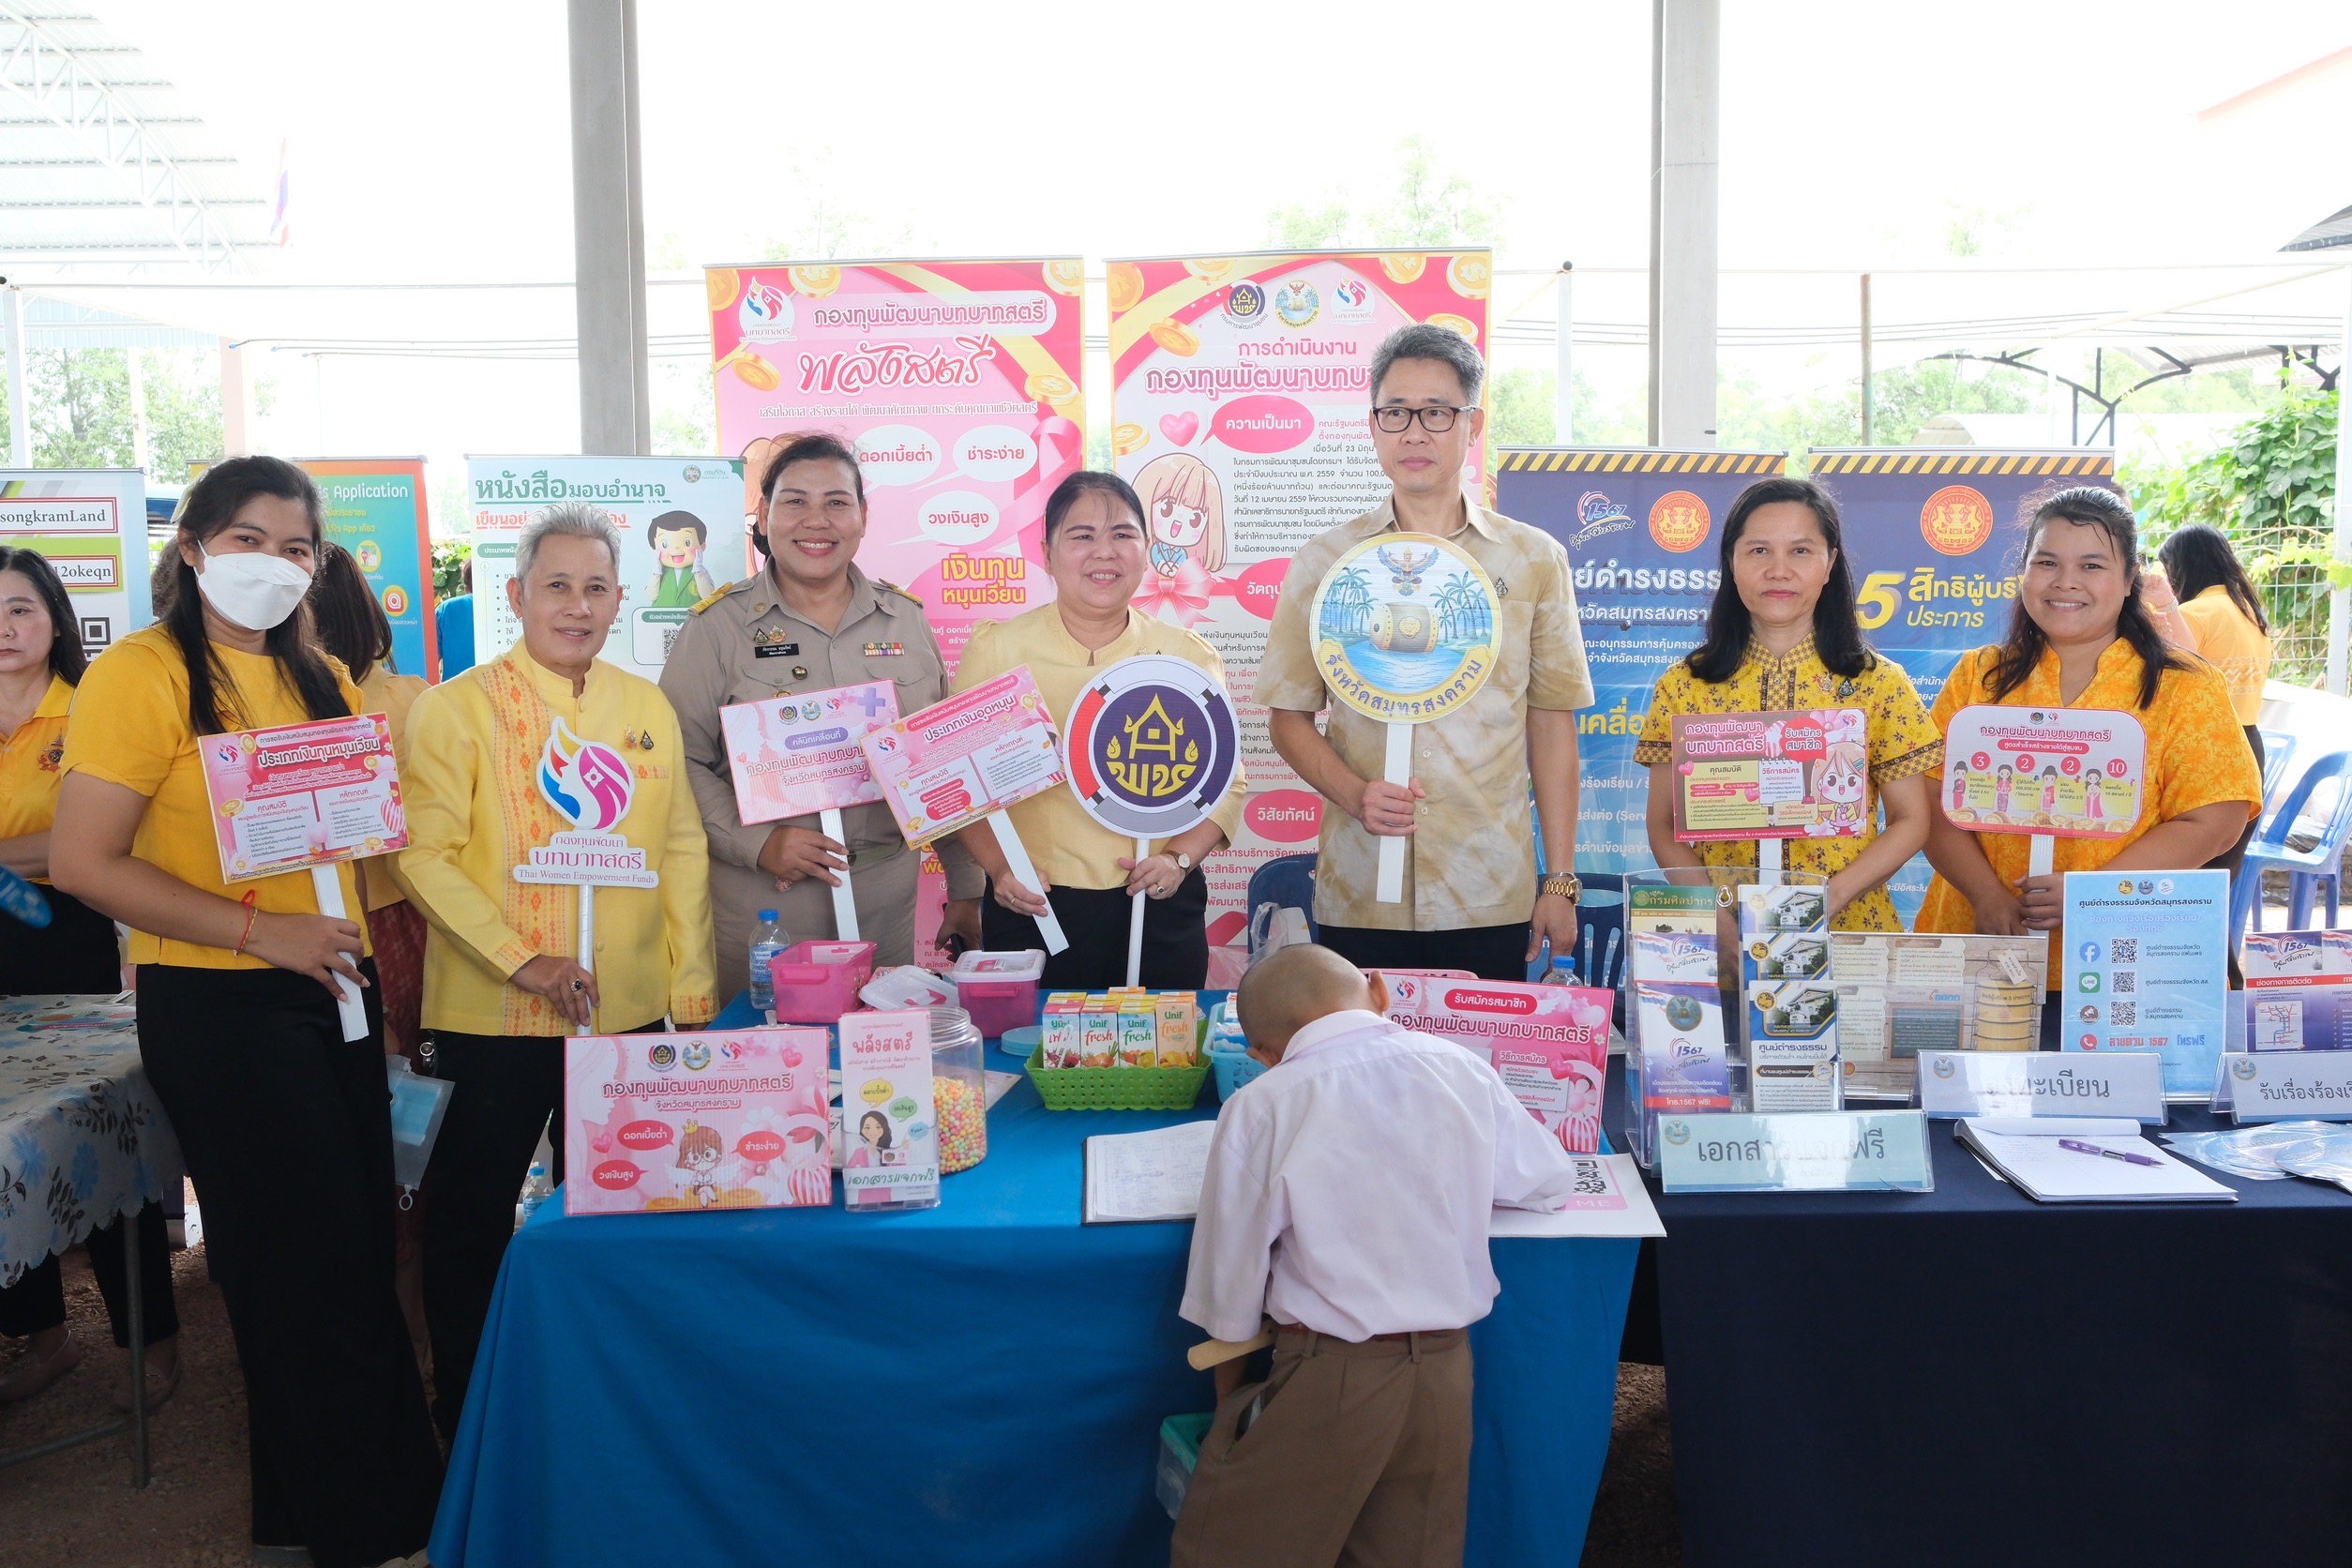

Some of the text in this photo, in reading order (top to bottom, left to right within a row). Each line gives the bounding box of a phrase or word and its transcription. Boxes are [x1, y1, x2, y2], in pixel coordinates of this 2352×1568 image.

[813, 300, 1046, 330] กองทุนพัฒนาบทบาทสตรี
[1238, 337, 1356, 357] การดำเนินงาน
[800, 336, 992, 392] พลังสตรี
[1226, 415, 1302, 430] ความเป็นมา
[859, 445, 933, 463] ดอกเบี้ยต่ำ
[967, 444, 1026, 462] ชำระง่าย
[1340, 469, 1364, 477] จำนวน
[334, 482, 409, 502] Application
[475, 470, 666, 499] หนังสือมอบอำนาจ
[1233, 494, 1249, 503] วันที่
[0, 509, 106, 526] songkramLand
[927, 509, 989, 527] วงเงินสูง
[1586, 503, 1627, 521] 1567
[942, 553, 1025, 586] เงินทุน
[942, 585, 1026, 609] หมุนเวียน
[1856, 572, 1906, 629] 5
[1907, 605, 1984, 627] ประการ
[925, 694, 1015, 743] ประเภทเงินอุดหนุน
[1686, 719, 1763, 737] กองทุนพัฒนา
[1786, 728, 1821, 739] รับสมัคร
[1980, 724, 2111, 742] กองทุนพัฒนาบทบาทสตรี
[1687, 733, 1765, 753] บทบาทสตรี
[1787, 739, 1822, 750] สมาชิก
[259, 738, 381, 767] ประเภทเงินทุนหมุนเวียน
[1710, 764, 1741, 775] คุณสมบัติ
[1977, 756, 1984, 767] 3
[2021, 758, 2029, 769] 2
[2066, 760, 2074, 772] 2
[2110, 761, 2125, 774] 10
[257, 801, 288, 813] คุณสมบัติ
[1258, 807, 1315, 822] วิสัยทัศน์
[555, 835, 624, 849] กองทุนพัฒนา
[535, 851, 642, 869] บทบาทสตรี
[519, 869, 655, 884] Thai Women Empowerment Funds
[1677, 943, 1703, 956] 1567
[2284, 942, 2308, 953] 1567
[1454, 991, 1527, 1009] รับสมัครสมาชิก
[1164, 1011, 1184, 1019] Unif
[1089, 1019, 1108, 1028] Unif
[1127, 1019, 1147, 1028] Unif
[1161, 1021, 1189, 1038] fresh
[852, 1031, 912, 1053] พลังสตรี
[1085, 1029, 1113, 1046] fresh
[1123, 1029, 1153, 1046] fresh
[2148, 1036, 2168, 1047] 1567
[1500, 1051, 1546, 1063] วิธีการสมัคร
[1676, 1046, 1703, 1058] 1567
[603, 1073, 792, 1096] กองทุนพัฒนาบทบาทสตรี
[656, 1098, 739, 1111] จังหวัดสมุทรสงคราม
[624, 1126, 668, 1140] ดอกเบี้ยต่ำ
[745, 1140, 779, 1152] ชำระง่าย
[598, 1169, 634, 1182] วงเงินสูง
